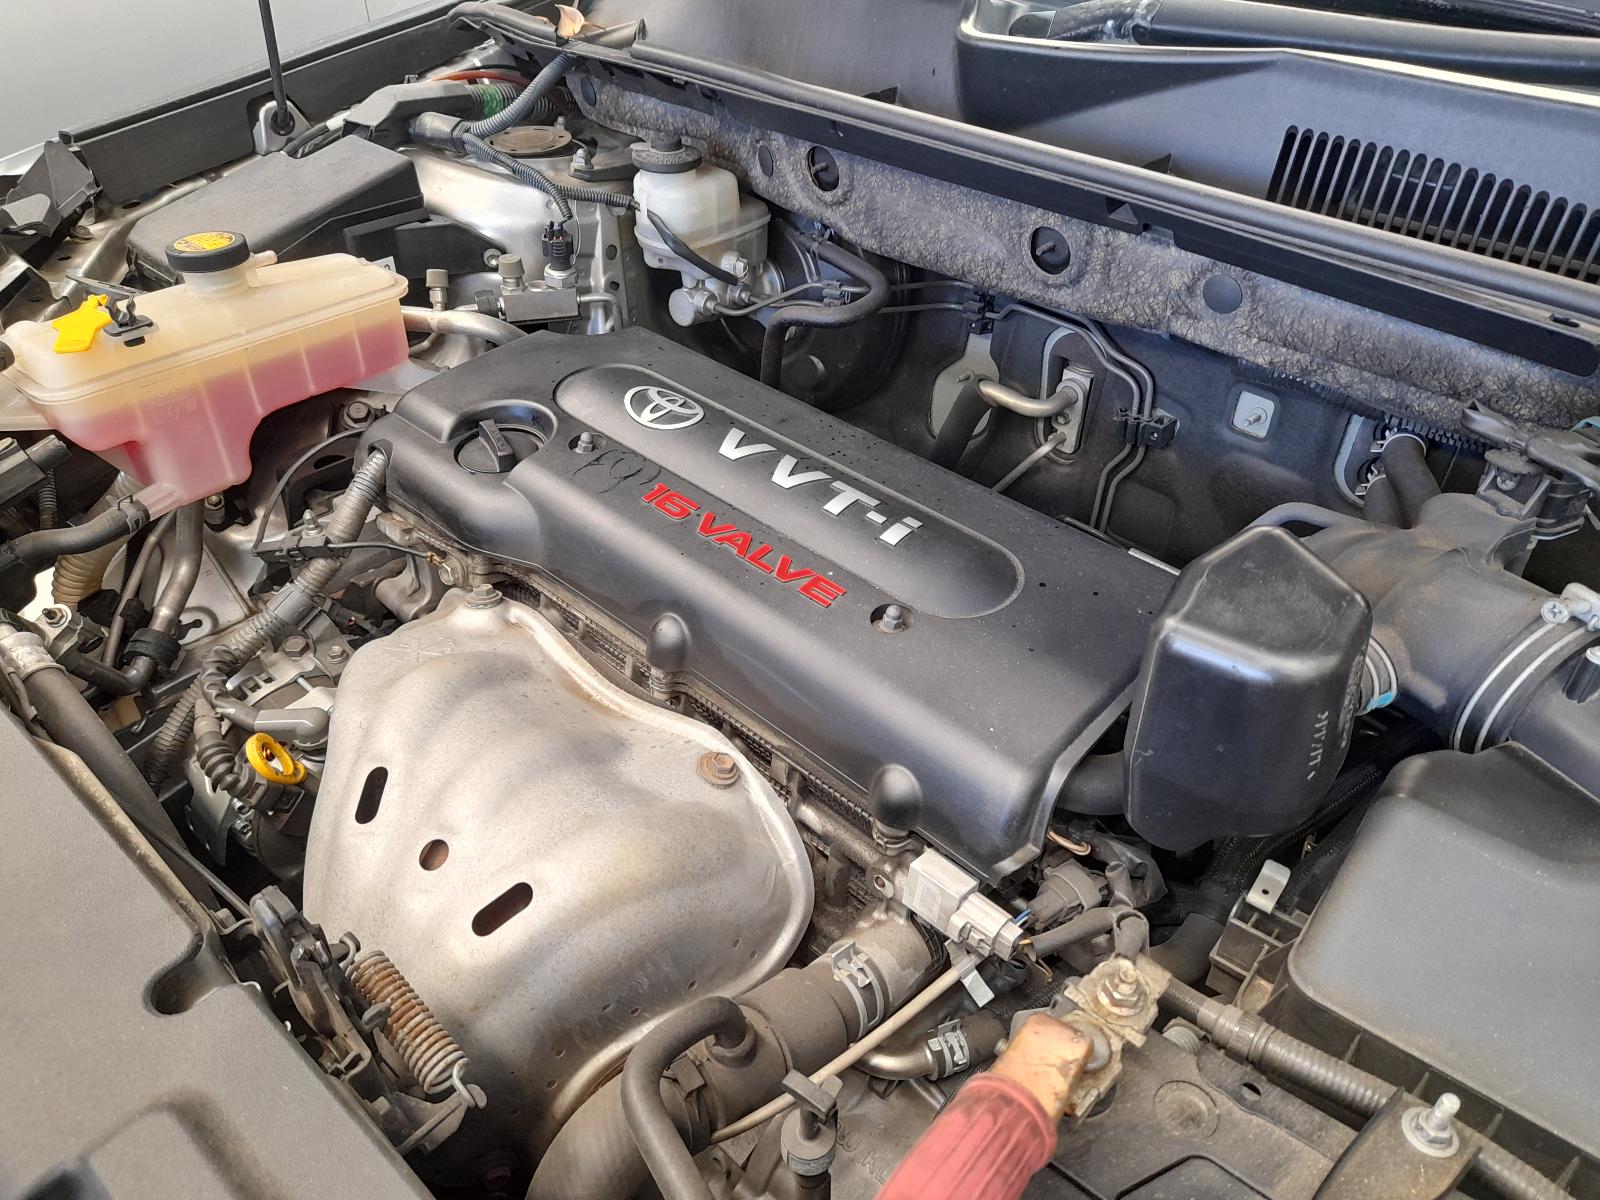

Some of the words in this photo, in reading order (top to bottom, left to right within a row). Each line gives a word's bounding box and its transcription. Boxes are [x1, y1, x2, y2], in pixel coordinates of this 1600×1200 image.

[641, 482, 701, 520] 16
[697, 511, 848, 608] VALVE
[718, 427, 925, 546] VVT-i
